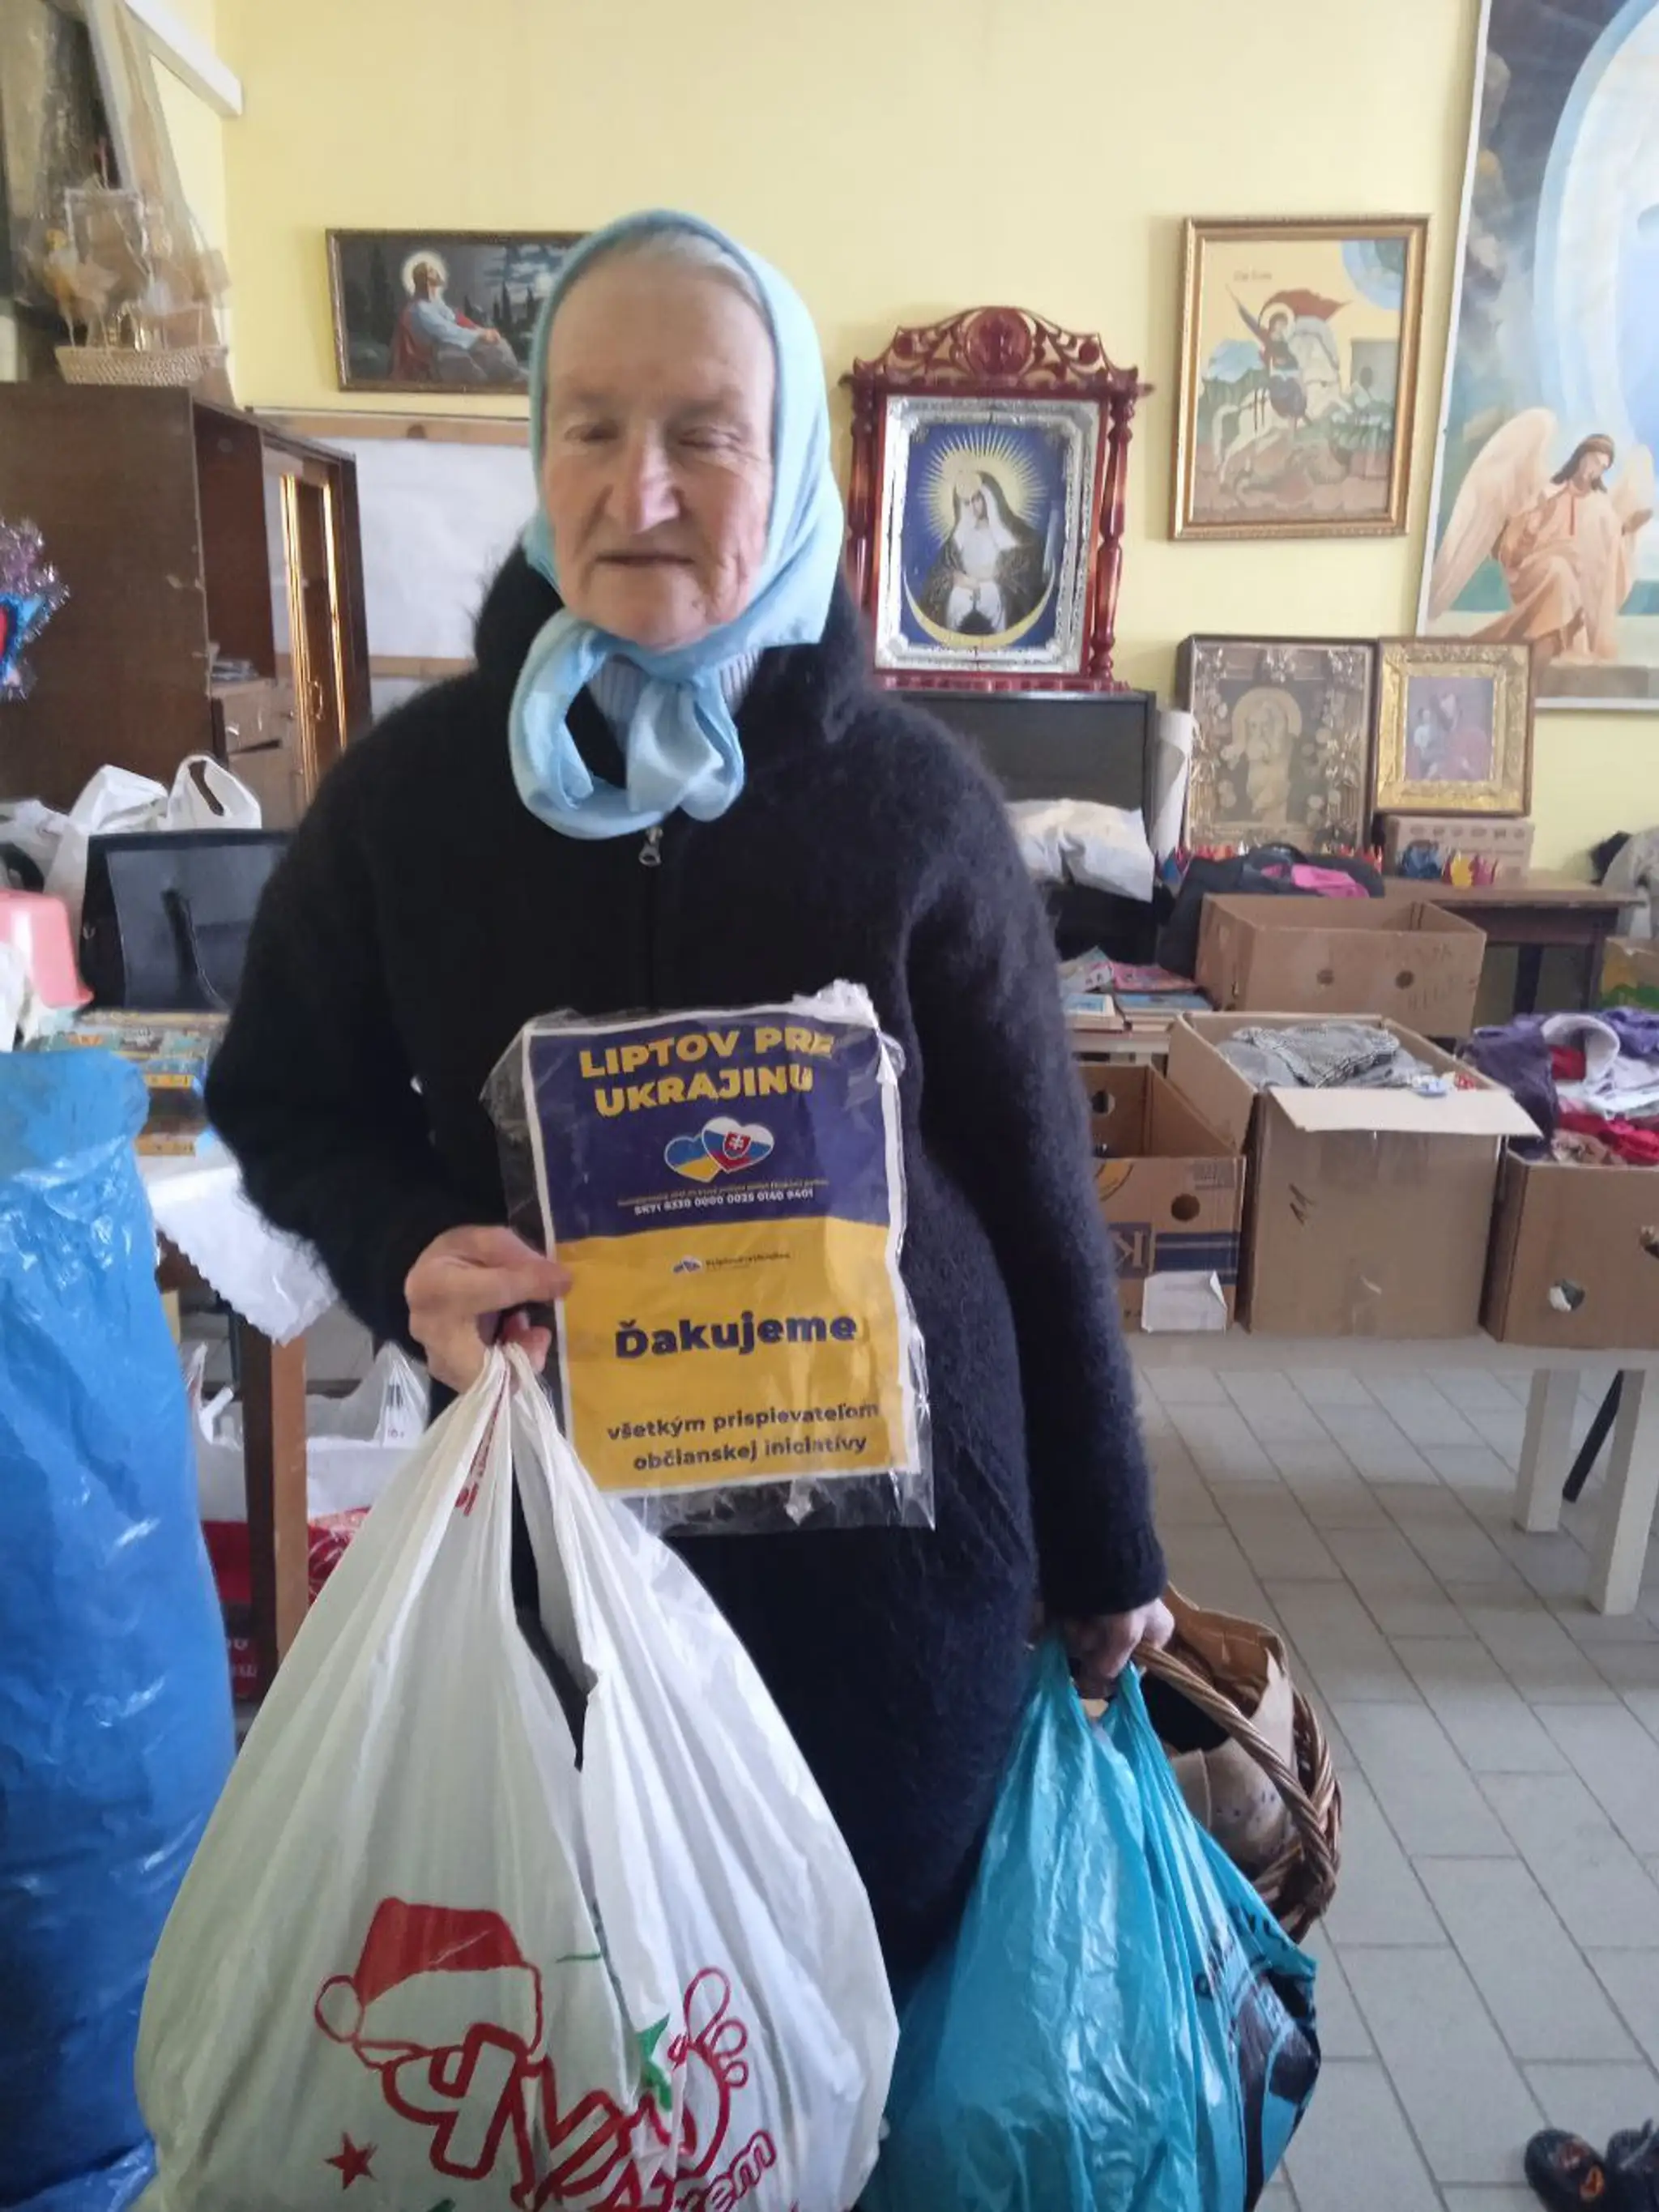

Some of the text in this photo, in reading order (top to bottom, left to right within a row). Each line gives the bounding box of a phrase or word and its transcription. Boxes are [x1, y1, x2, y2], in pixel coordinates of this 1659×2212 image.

[579, 1026, 835, 1078] LIPTOV PRE
[594, 1063, 813, 1117] UKRAJINU
[615, 1310, 857, 1357] Ďakujeme
[606, 1414, 706, 1441] všetkým
[633, 1441, 758, 1471] občianskej
